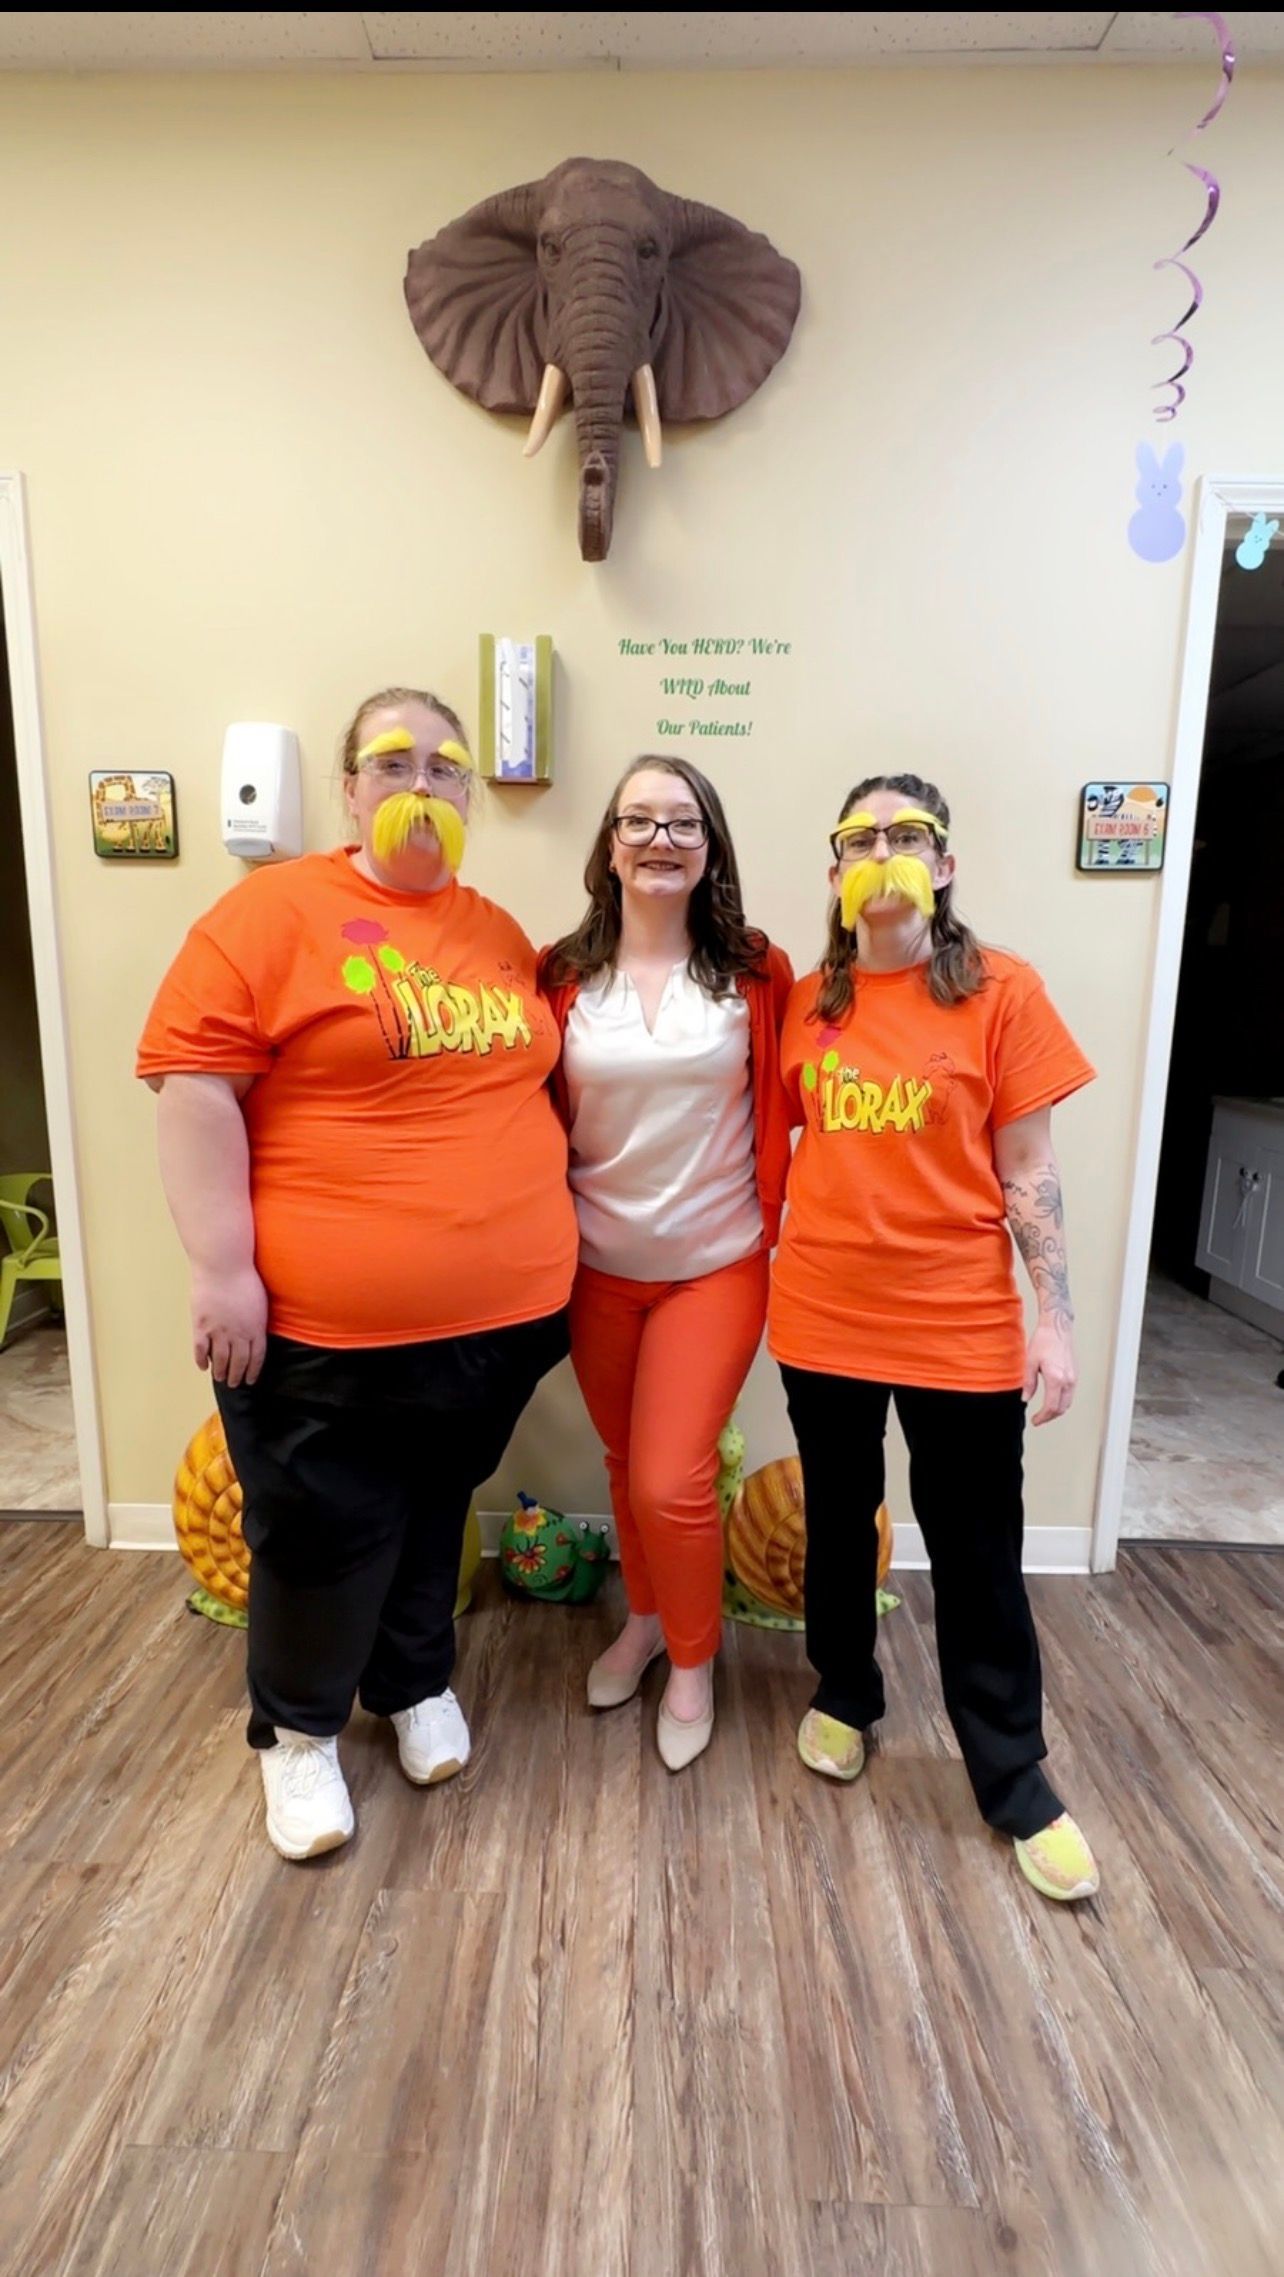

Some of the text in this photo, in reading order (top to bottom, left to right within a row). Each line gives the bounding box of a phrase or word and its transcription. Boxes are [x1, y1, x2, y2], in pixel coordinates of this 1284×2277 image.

[618, 638, 792, 656] Have You HERD? We're
[660, 678, 751, 700] WILD About
[656, 718, 753, 737] Our Patients!
[392, 977, 533, 1059] LORAX
[823, 1074, 933, 1134] LORAX
